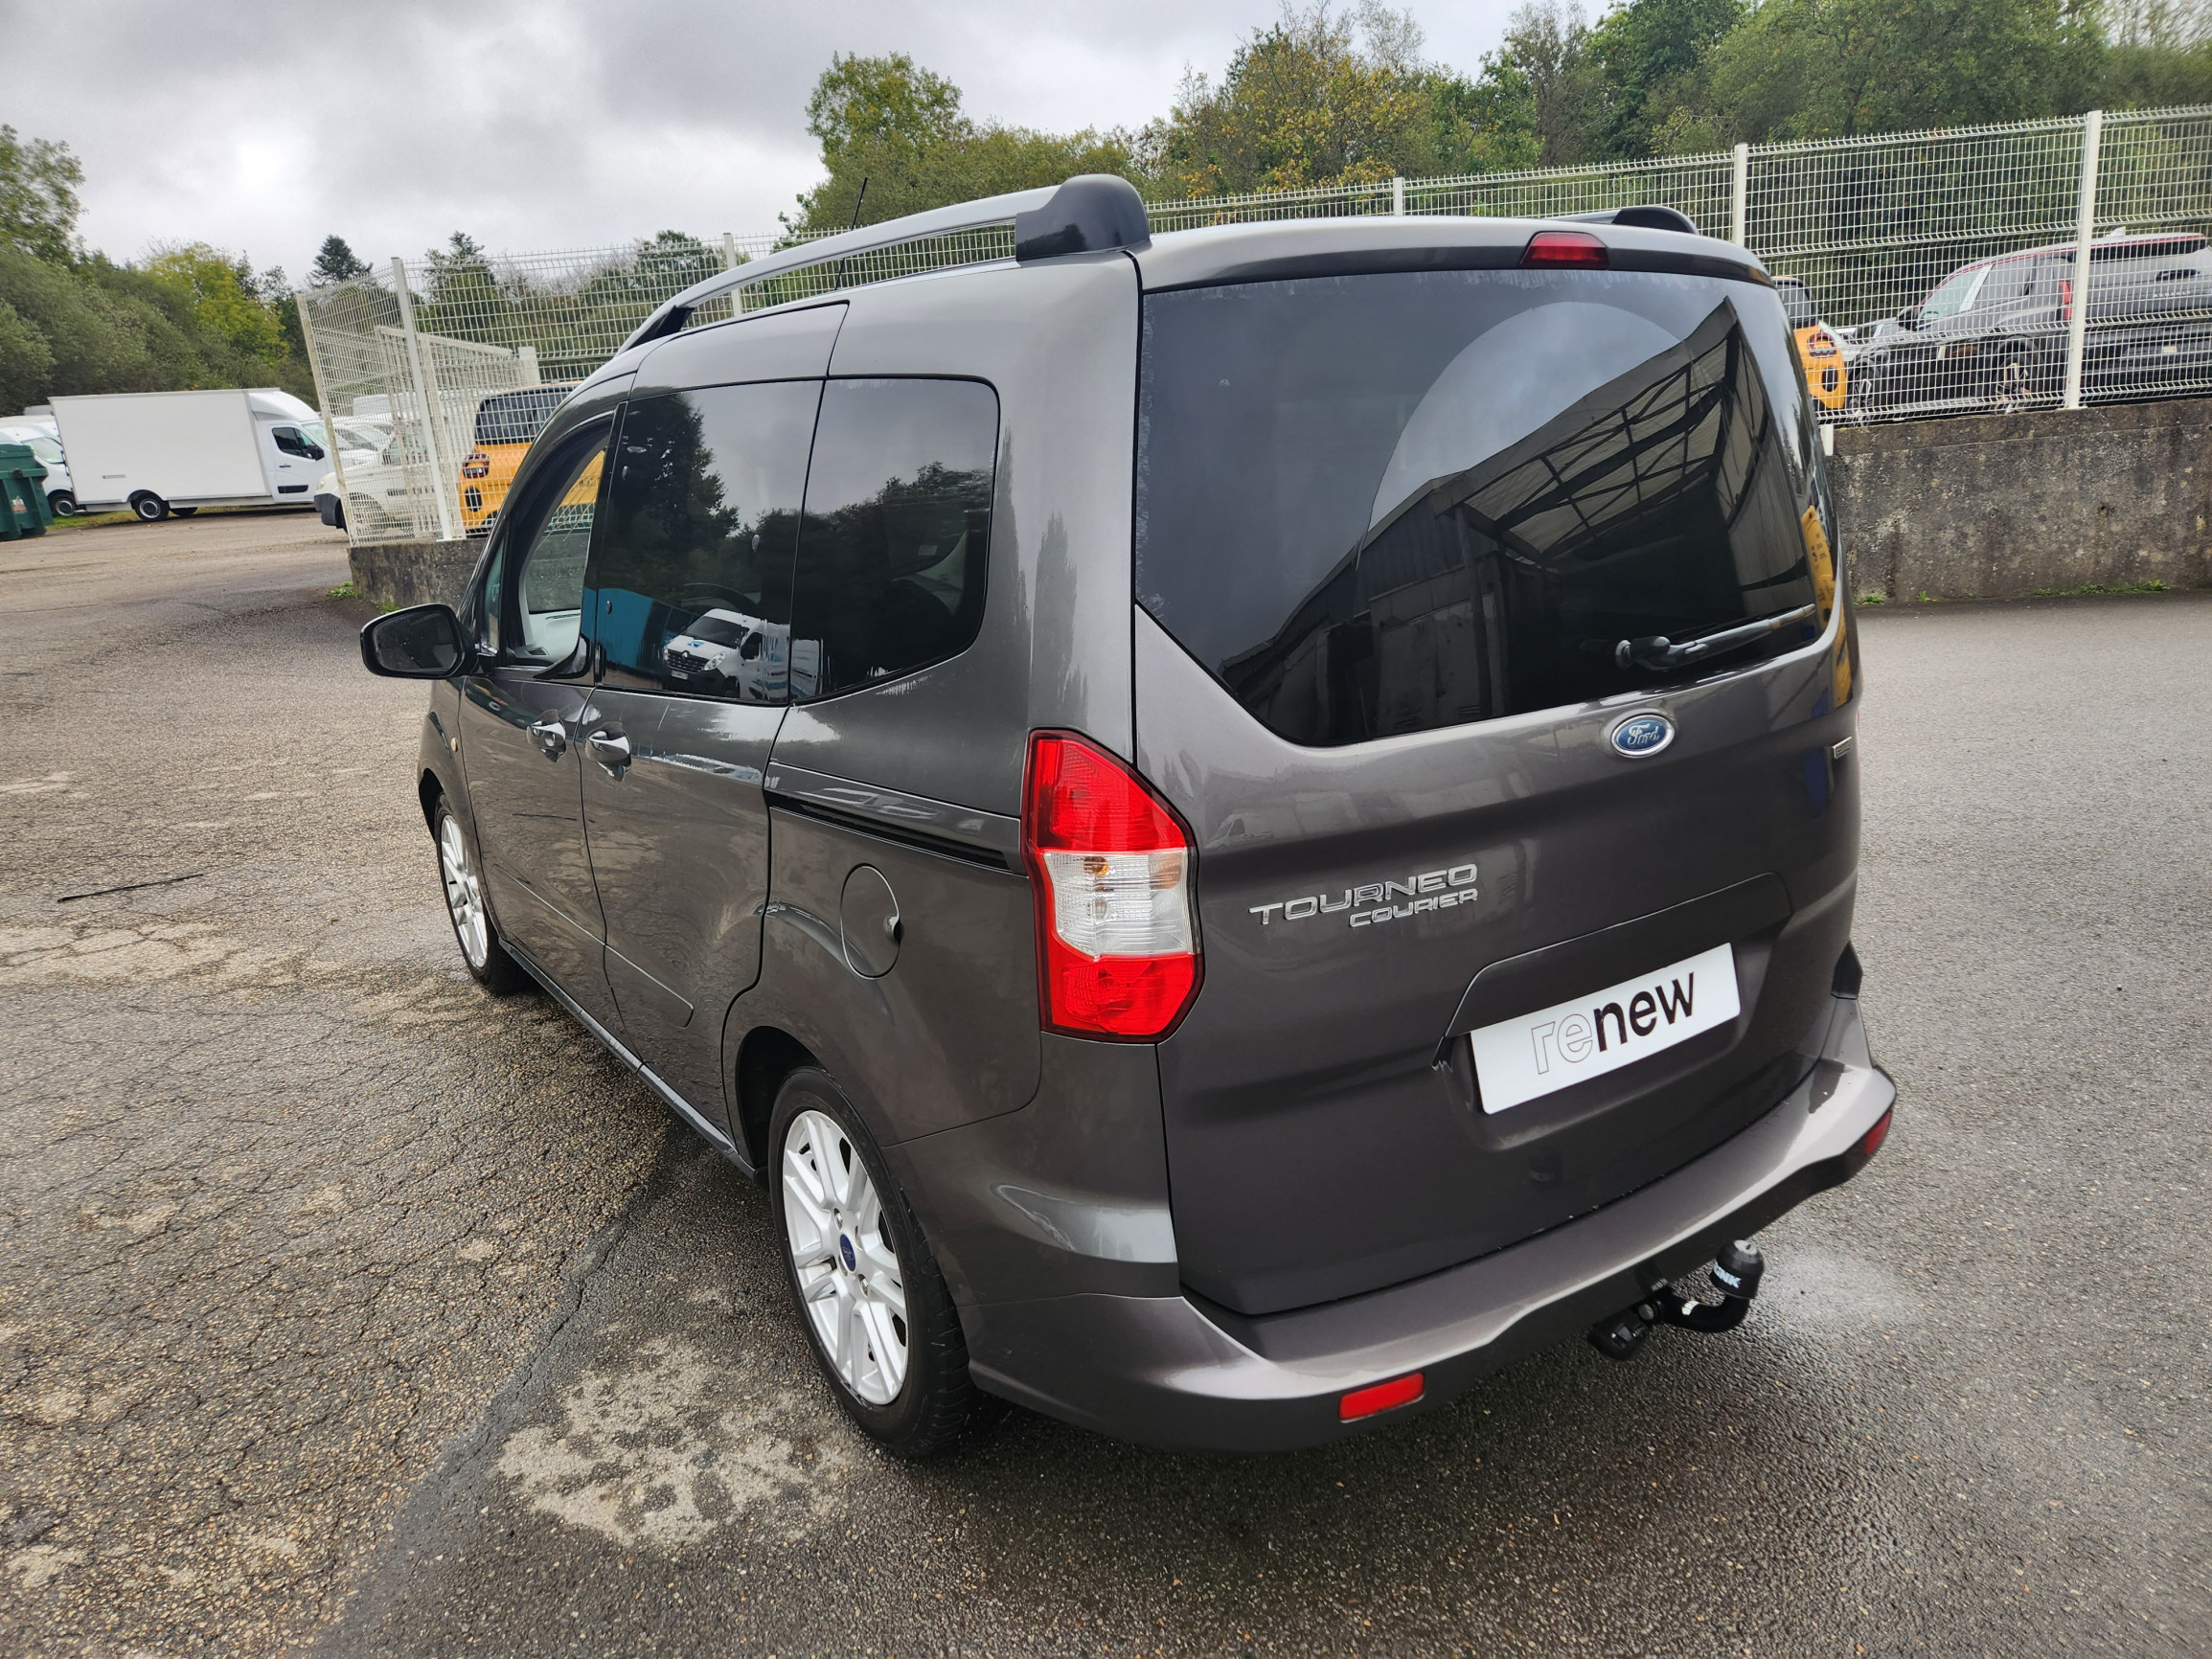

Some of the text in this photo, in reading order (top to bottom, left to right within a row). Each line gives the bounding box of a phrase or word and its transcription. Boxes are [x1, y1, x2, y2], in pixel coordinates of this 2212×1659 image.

[1627, 723, 1660, 745] Ford
[1249, 863, 1478, 925] TOURNEO
[1349, 888, 1479, 927] COURIER
[1531, 971, 1695, 1075] renew
